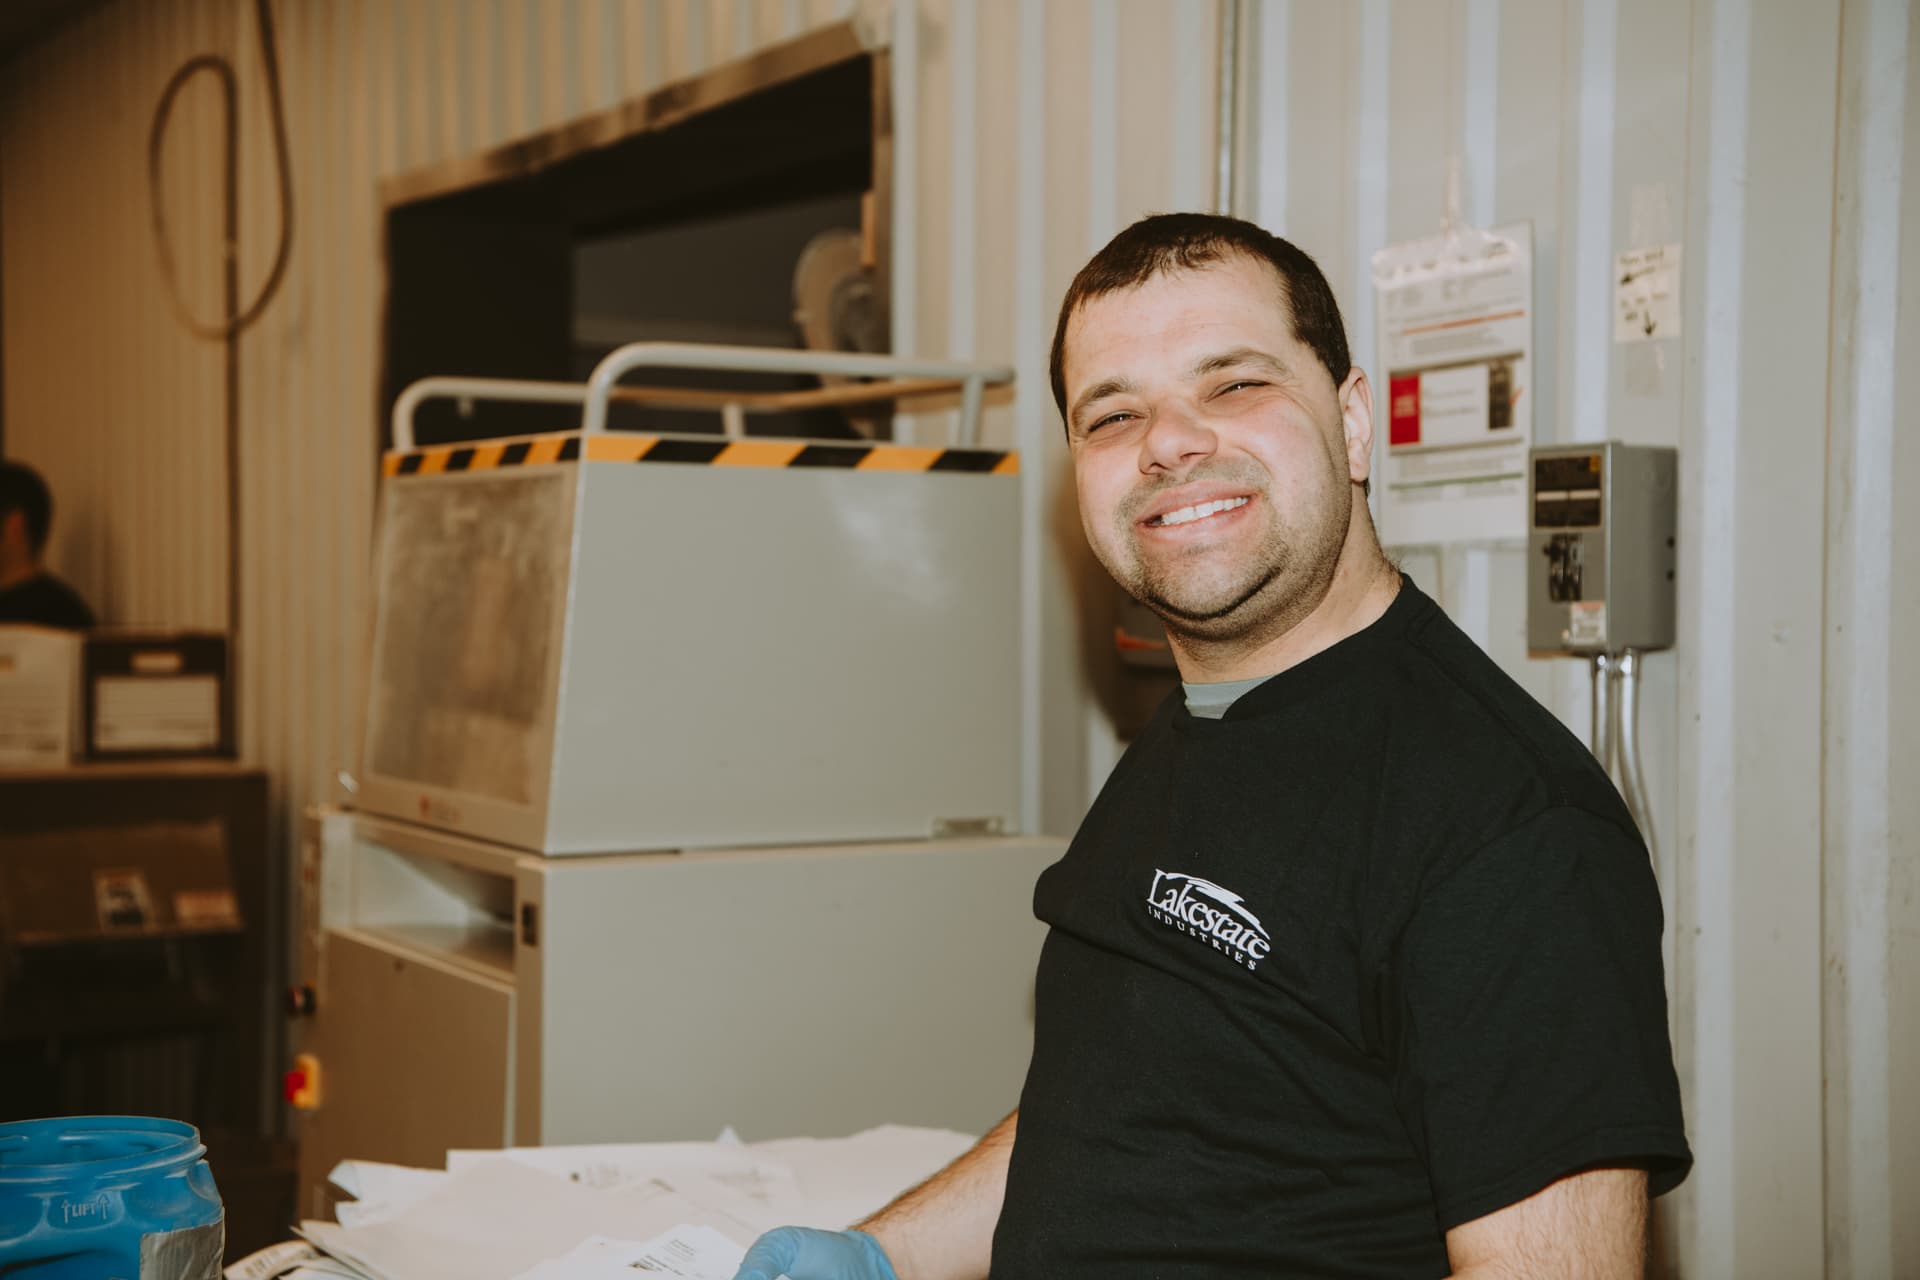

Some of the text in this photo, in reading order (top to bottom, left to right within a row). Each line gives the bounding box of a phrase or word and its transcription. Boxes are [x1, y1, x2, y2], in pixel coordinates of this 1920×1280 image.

[1147, 868, 1271, 960] Lakestate
[1148, 905, 1257, 971] INDUSTRIES
[71, 1202, 97, 1217] LIFT
